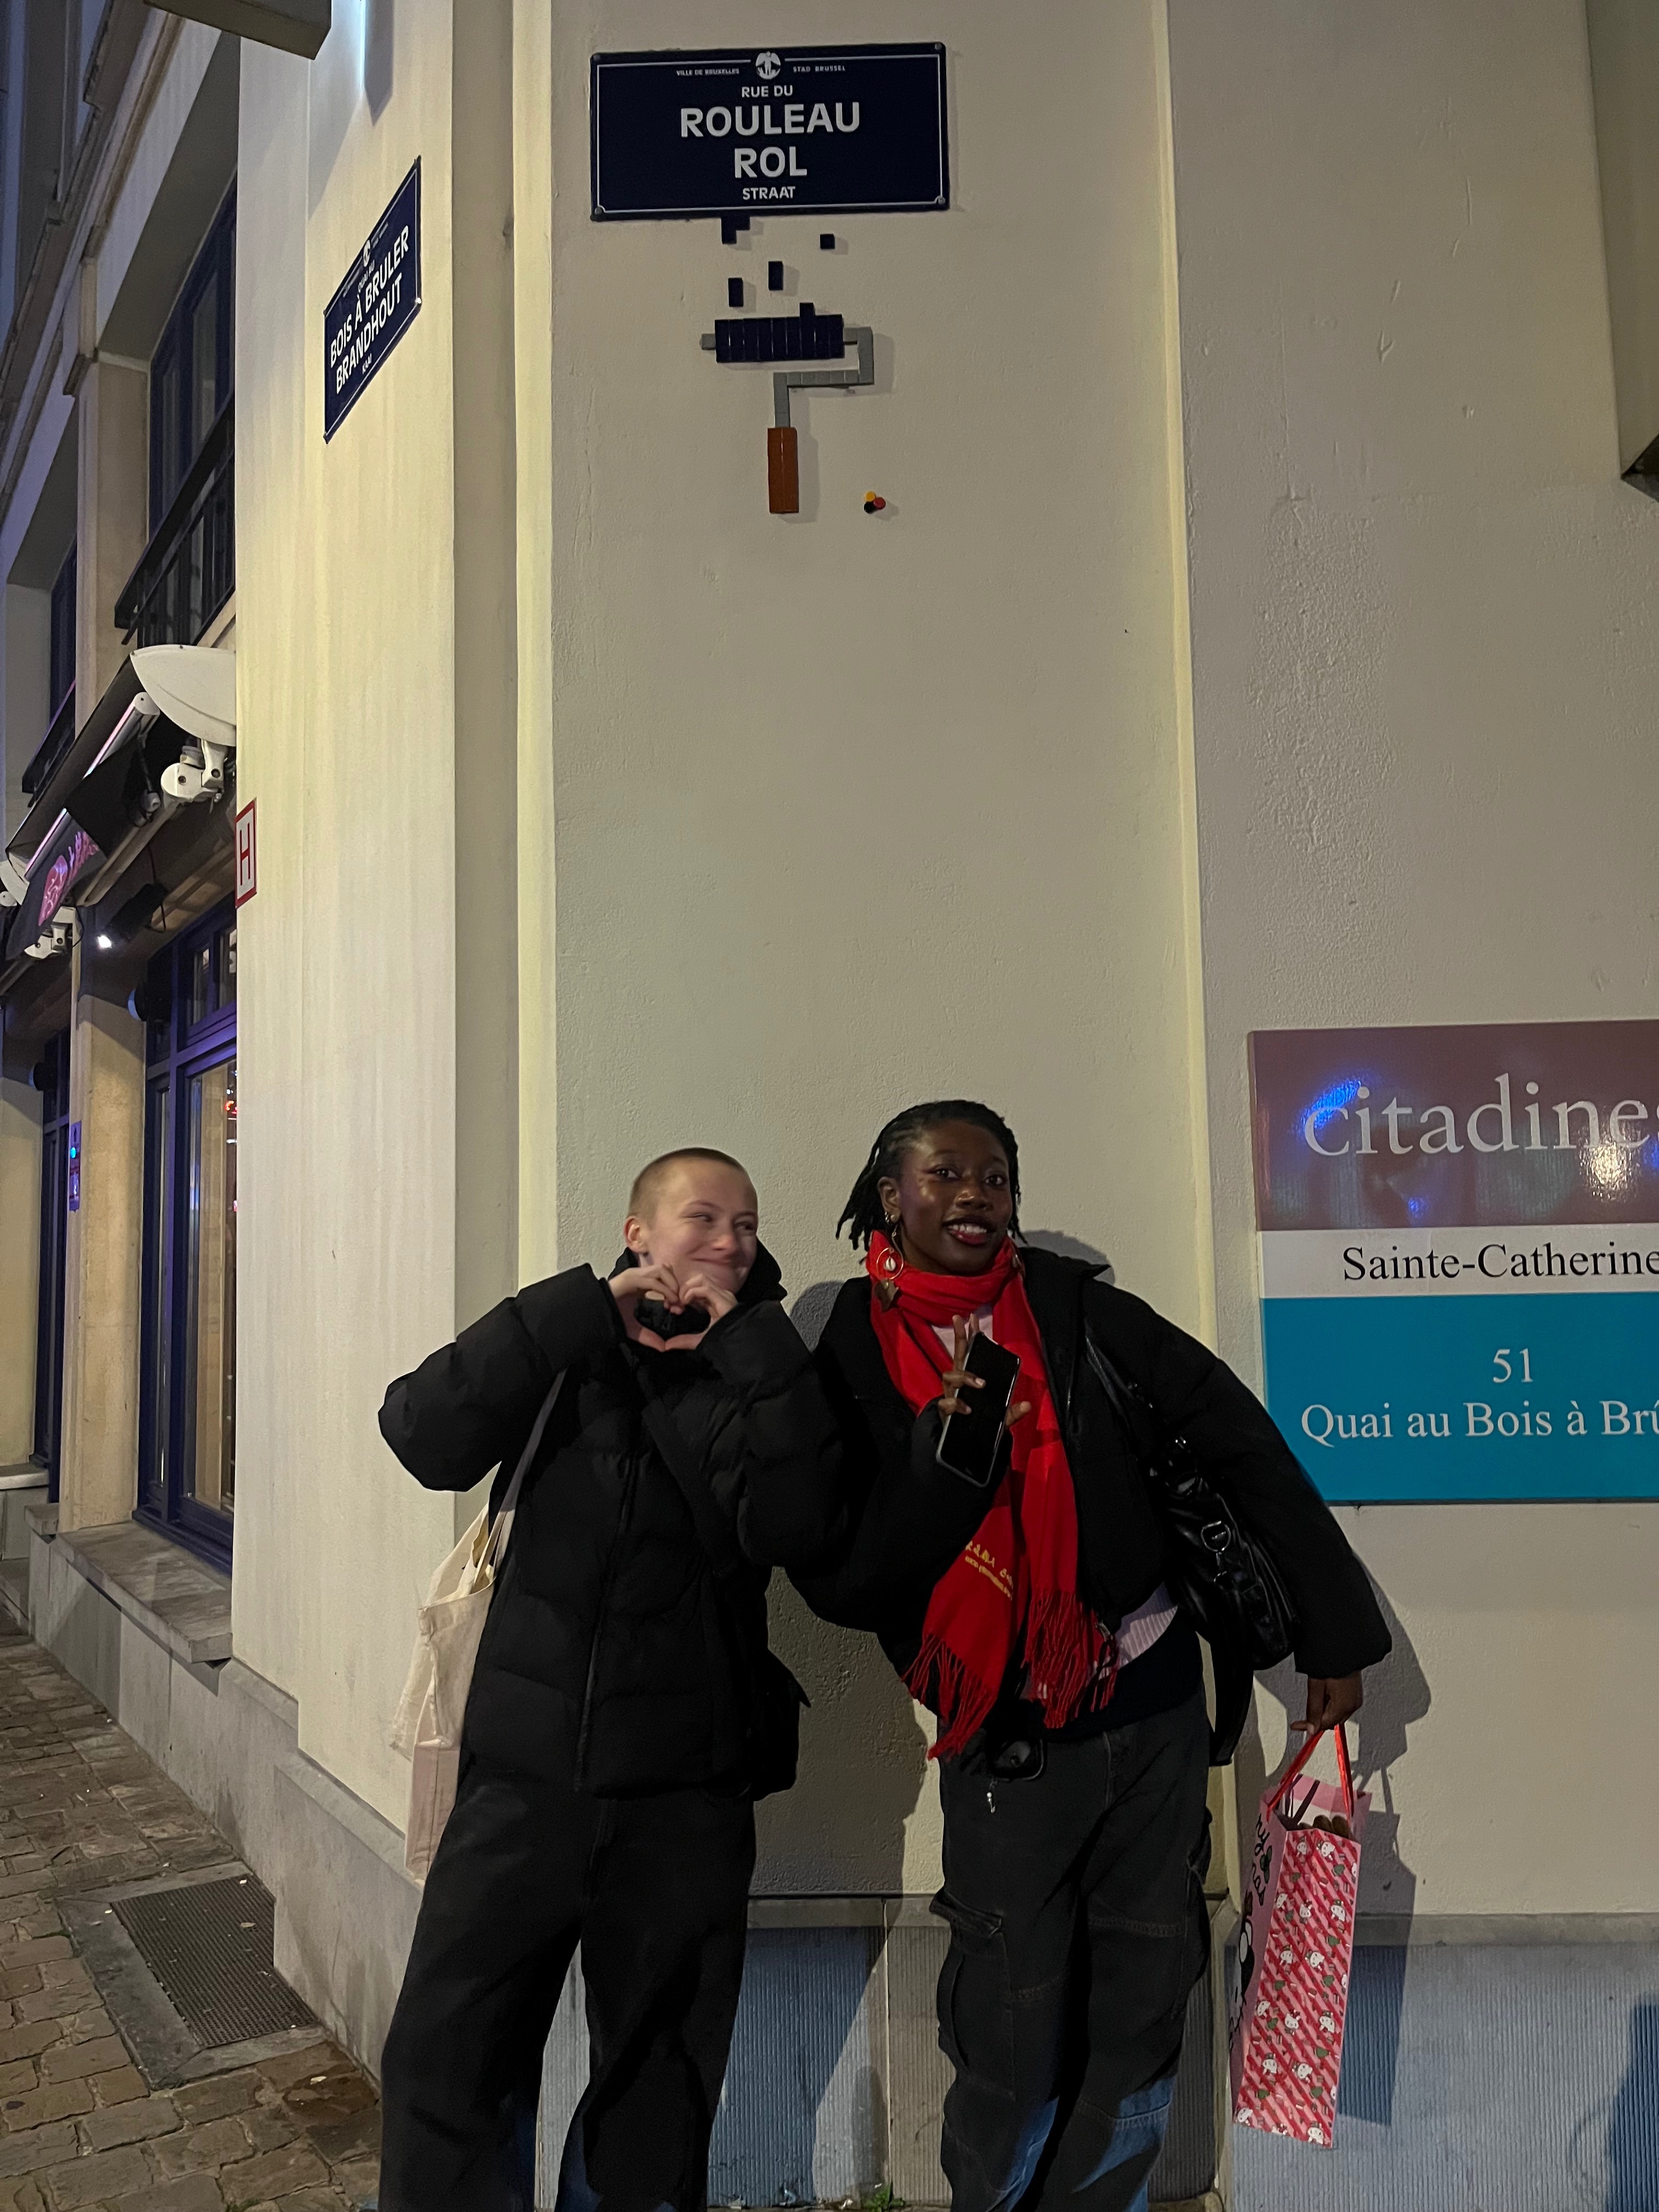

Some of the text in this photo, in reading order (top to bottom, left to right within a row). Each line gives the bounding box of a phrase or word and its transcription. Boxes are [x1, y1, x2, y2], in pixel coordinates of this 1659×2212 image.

[742, 84, 793, 98] RUE DU
[680, 101, 860, 137] ROULEAU
[735, 145, 807, 178] ROL
[742, 185, 795, 200] STRAAT
[330, 312, 352, 368] BOIS
[354, 294, 362, 331] À
[365, 225, 409, 308] BRULER
[336, 273, 403, 394] BRANDHOUT
[1304, 1072, 1659, 1157] citadine
[1342, 1241, 1659, 1282] Sainte-Catherine
[1492, 1348, 1534, 1384] 51
[1301, 1403, 1394, 1448] Quai
[1407, 1413, 1452, 1437] au
[1463, 1402, 1553, 1437] Bois
[1566, 1402, 1588, 1436] à
